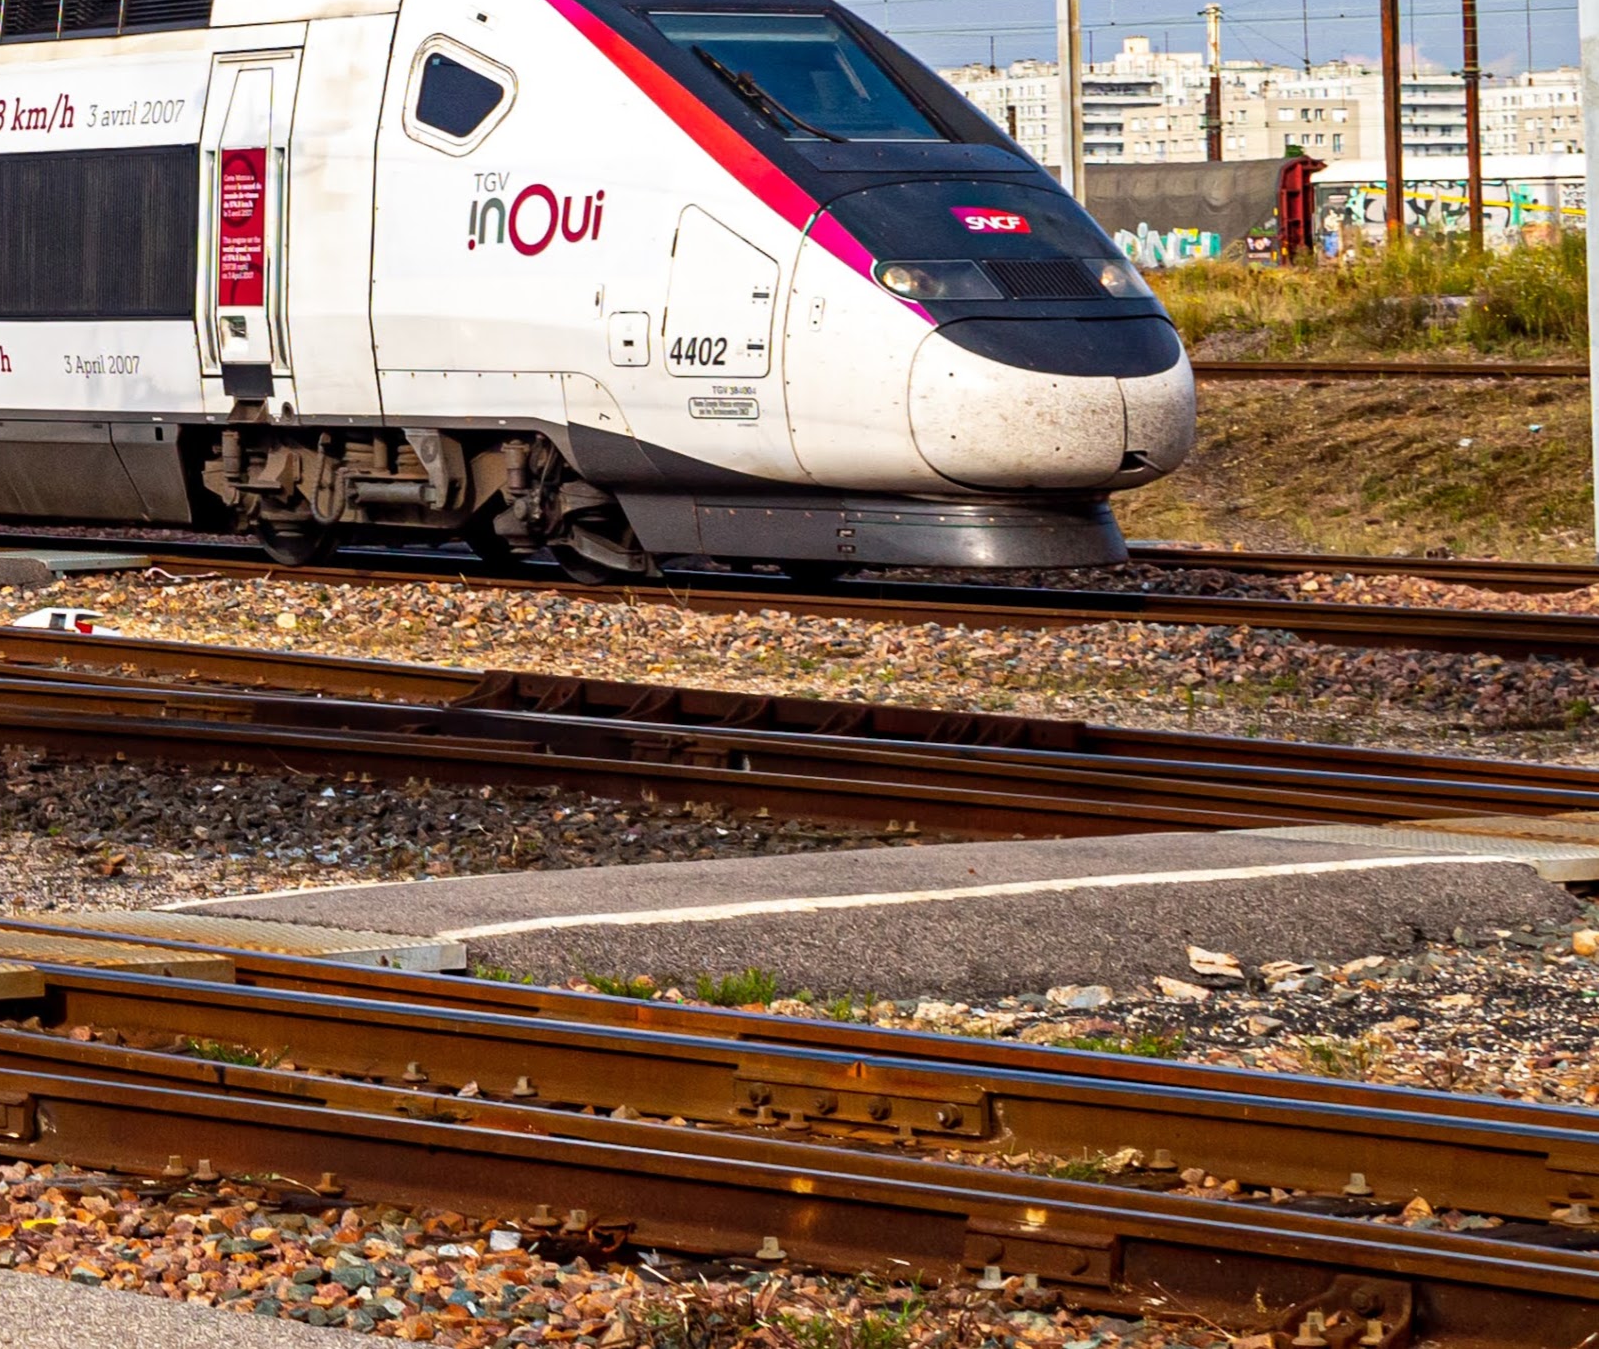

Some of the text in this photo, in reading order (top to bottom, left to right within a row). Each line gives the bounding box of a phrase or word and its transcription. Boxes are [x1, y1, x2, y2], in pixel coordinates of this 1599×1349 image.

[10, 93, 74, 134] km/h
[86, 104, 97, 128] 3
[101, 100, 136, 127] avril
[139, 99, 185, 125] 2007
[474, 171, 510, 193] TGV
[964, 215, 1021, 230] SNCF
[669, 337, 728, 366] 4402
[63, 355, 72, 374] 3
[75, 355, 106, 378] April
[108, 355, 140, 375] 2007
